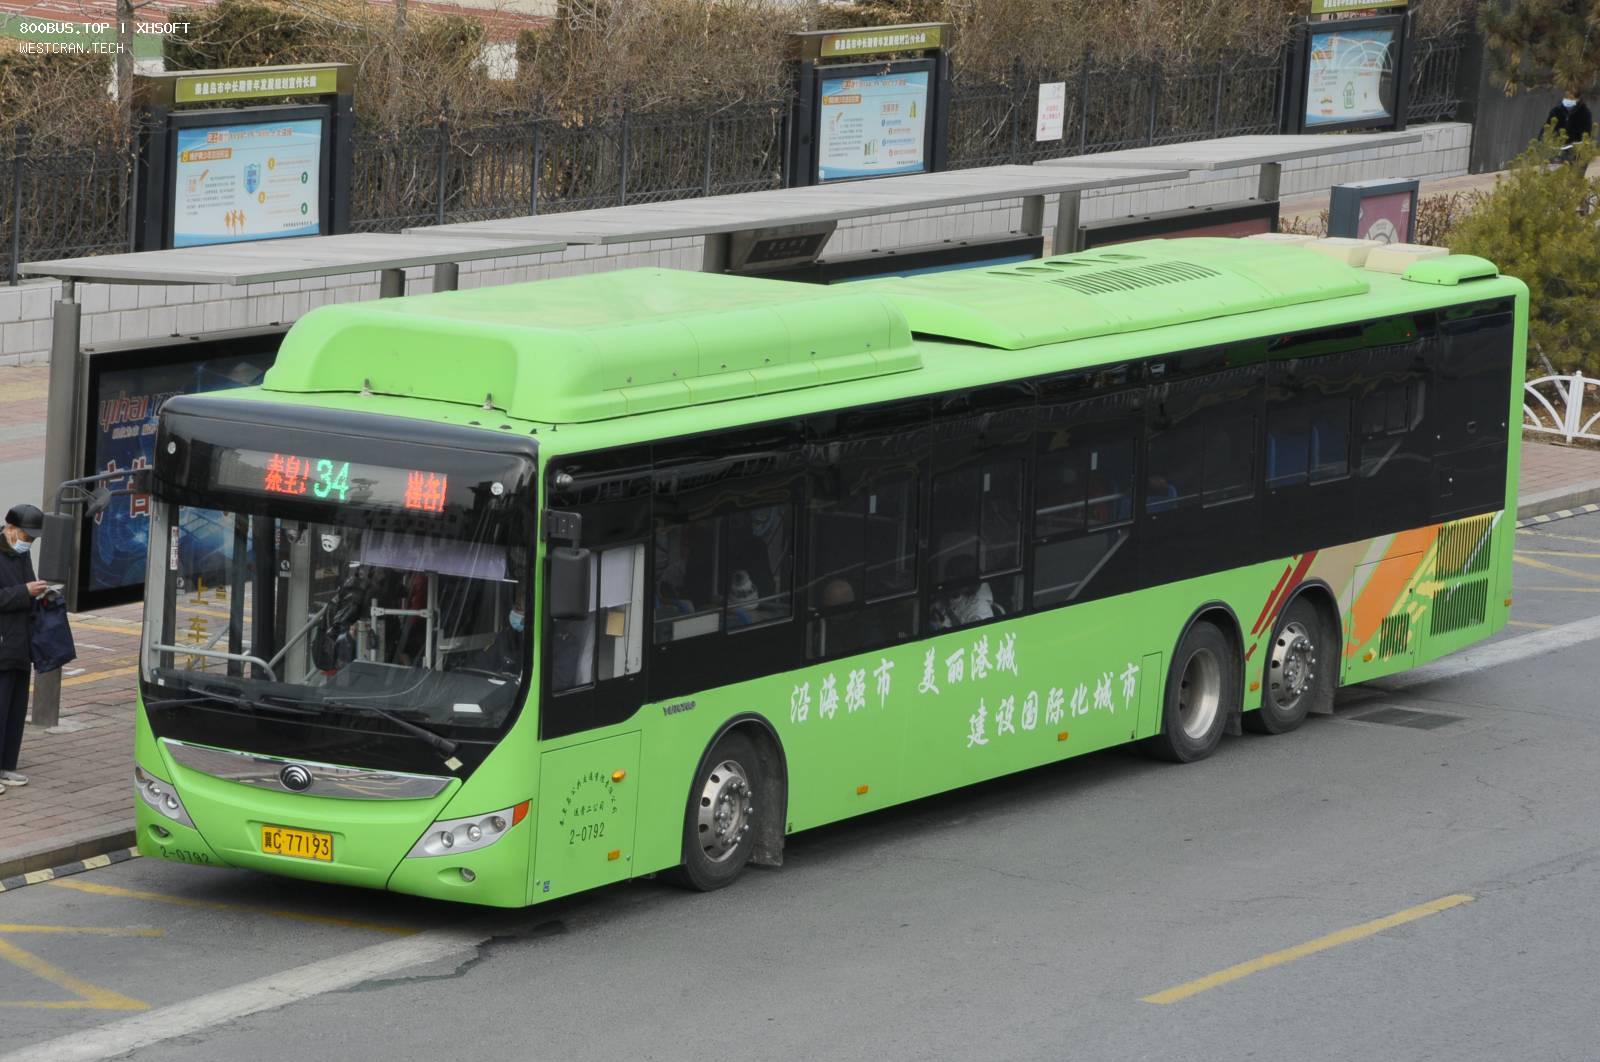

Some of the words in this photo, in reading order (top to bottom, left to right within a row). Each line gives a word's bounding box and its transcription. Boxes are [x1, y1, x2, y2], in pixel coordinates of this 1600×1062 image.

[313, 458, 351, 501] 34
[790, 658, 895, 724] 沿海强市
[918, 632, 1019, 695] 美丽港城
[967, 662, 1140, 748] 建设国际化城市
[160, 846, 213, 864] 2-0792
[569, 822, 605, 845] 2-0792
